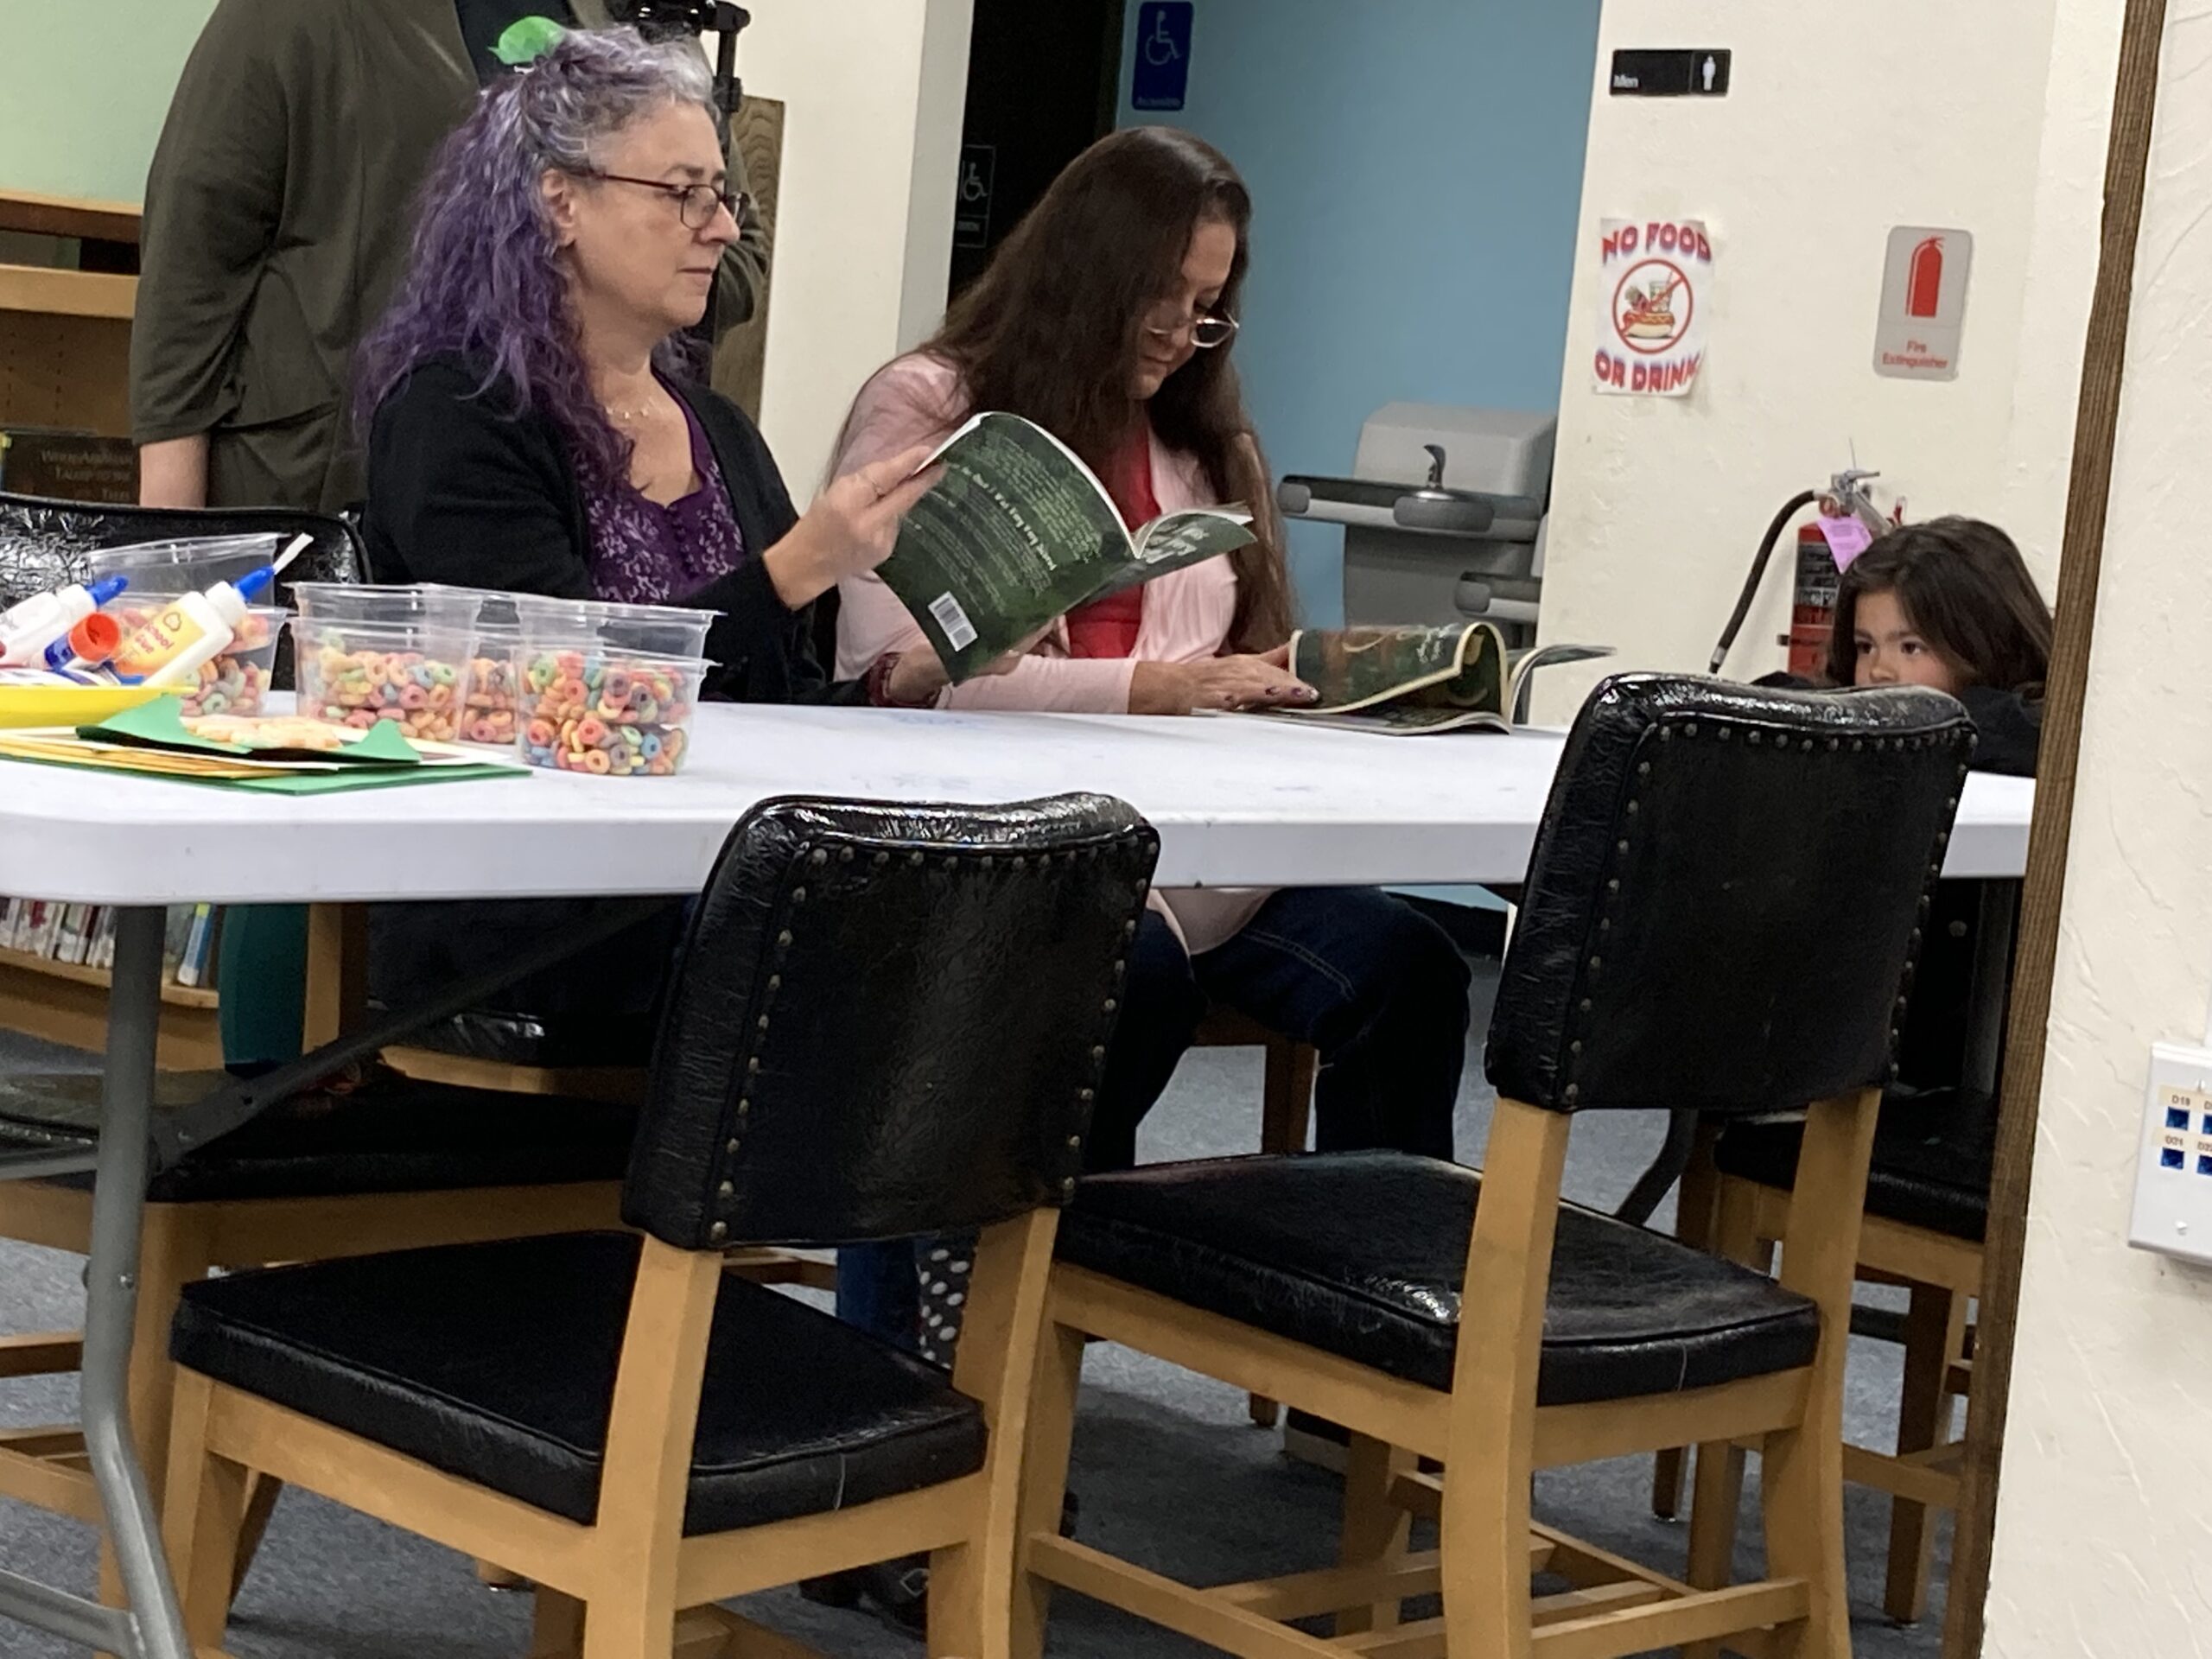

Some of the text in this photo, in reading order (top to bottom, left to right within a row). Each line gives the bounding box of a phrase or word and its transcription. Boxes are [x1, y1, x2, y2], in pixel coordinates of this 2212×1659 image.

[1602, 223, 1712, 264] NO FOOD
[1882, 352, 1948, 370] Extinguisher
[1906, 340, 1928, 353] Fire
[1594, 349, 1700, 392] OR DRINK
